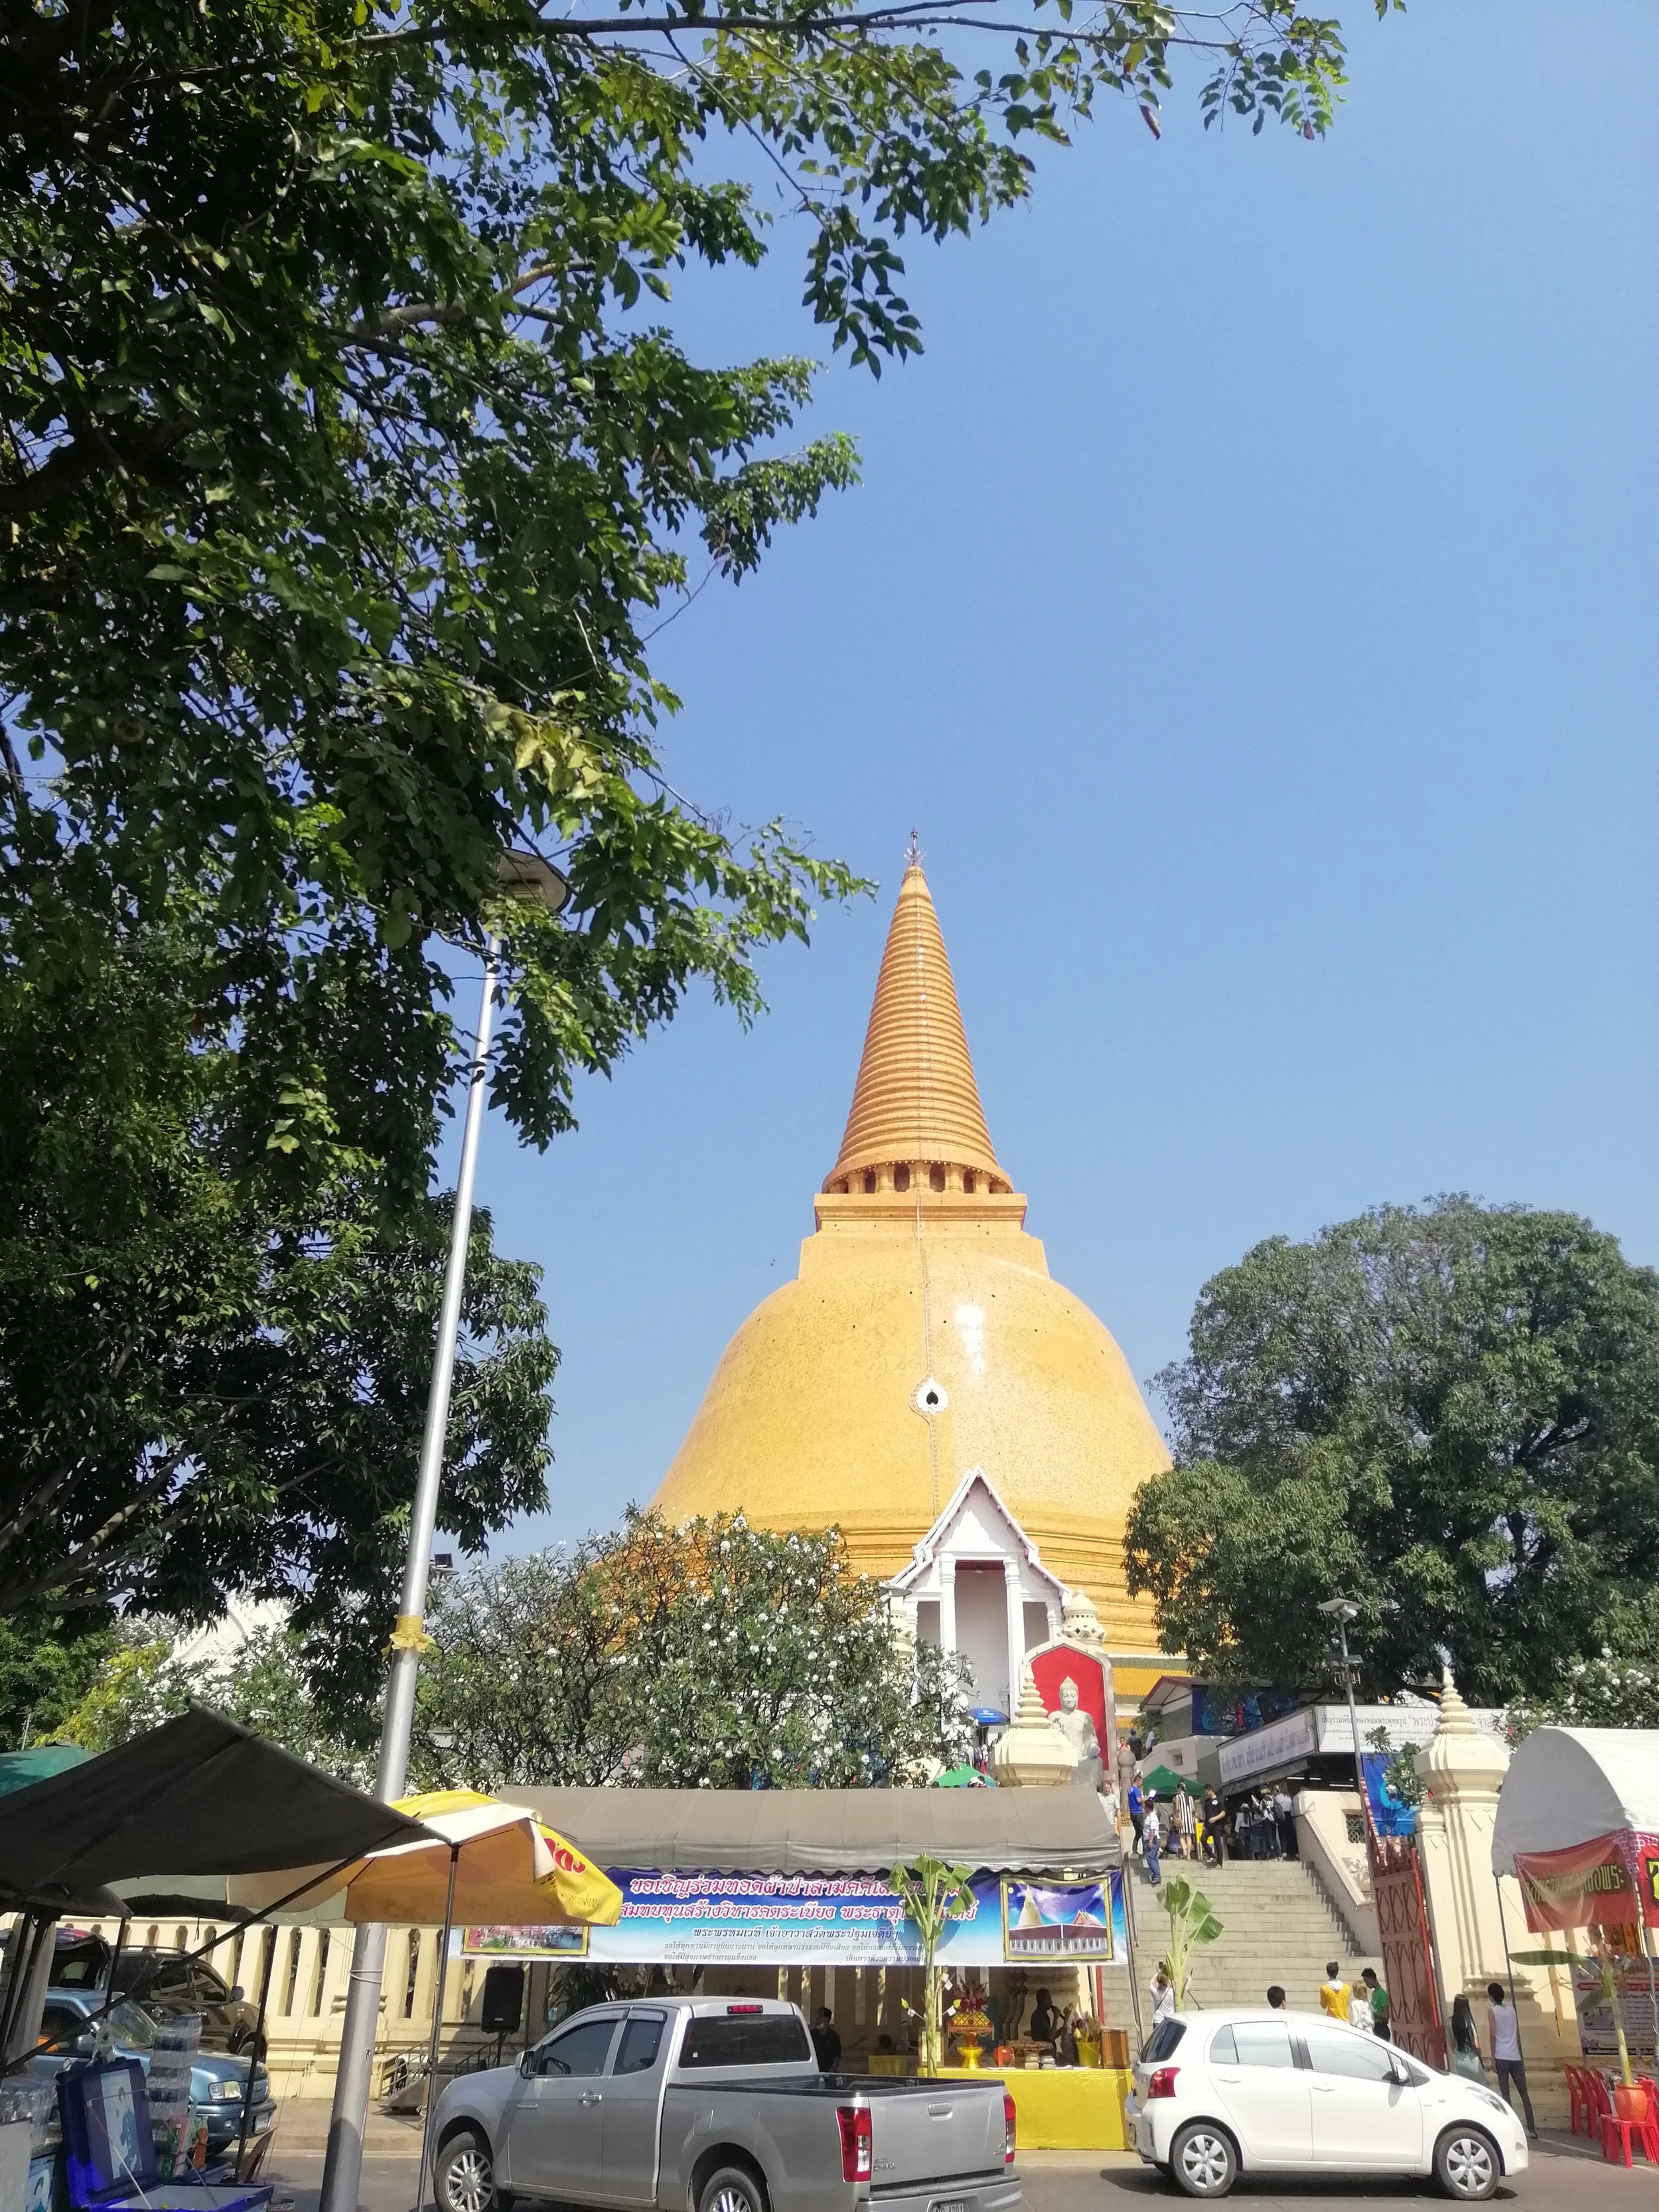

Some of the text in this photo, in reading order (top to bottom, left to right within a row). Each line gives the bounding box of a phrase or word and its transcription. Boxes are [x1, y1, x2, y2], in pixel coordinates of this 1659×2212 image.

[693, 1926, 762, 1937] พระพรหมเวที
[852, 1942, 924, 1953] ขอให้ครอบครัวมีความสุ
